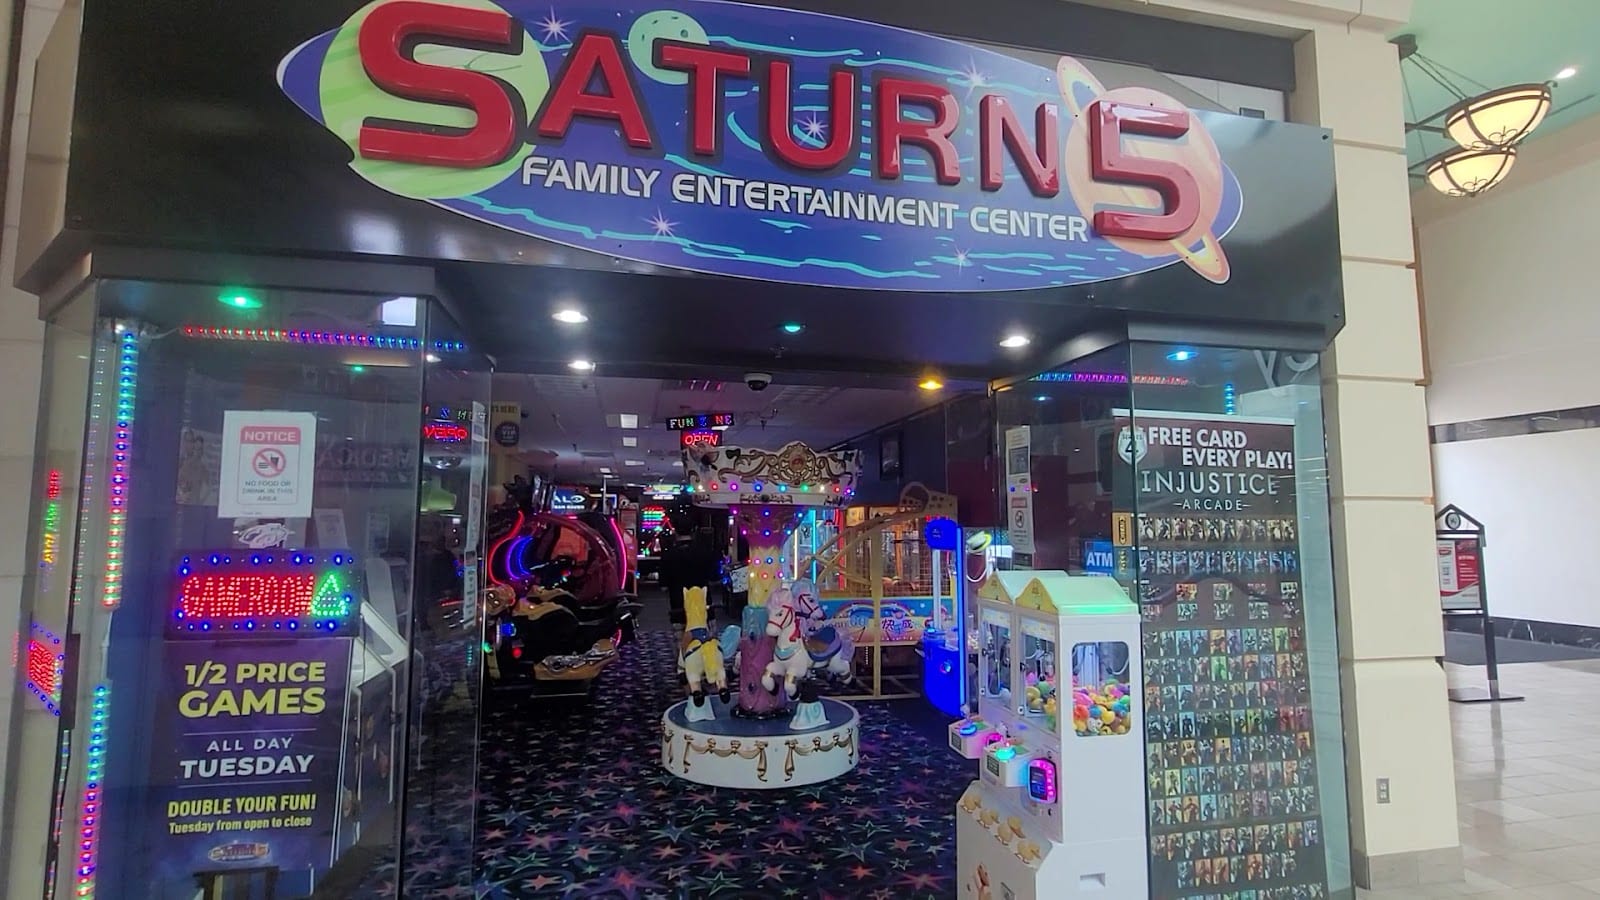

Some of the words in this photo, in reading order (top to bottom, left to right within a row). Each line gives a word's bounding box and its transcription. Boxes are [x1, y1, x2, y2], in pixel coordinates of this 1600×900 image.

[358, 0, 1060, 198] SATURN
[1089, 100, 1202, 240] 5
[522, 156, 661, 198] FAMILY
[672, 174, 960, 230] ENTERTAINMENT
[970, 206, 1089, 243] CENTER
[669, 417, 694, 429] FUN
[699, 414, 732, 427] ZNE
[244, 431, 297, 442] NOTICE
[684, 434, 719, 446] OPEN
[1148, 426, 1192, 447] FREE
[1196, 428, 1248, 449] CARD
[1182, 447, 1241, 468] EVERY
[1245, 450, 1293, 470] PLAY!
[1141, 470, 1281, 495] INJUSTICE
[1182, 499, 1243, 511] ARCADE
[1086, 552, 1113, 568] ATM
[183, 575, 315, 617] GAMEROOM
[184, 660, 227, 687] 1/2
[236, 662, 326, 684] PRICE
[178, 686, 326, 718] GAMES
[207, 739, 244, 752] ALL
[254, 737, 293, 750] DAY
[180, 754, 314, 779] TUESDAY
[167, 798, 233, 818] DOUBLE
[236, 796, 276, 813] YOUR
[280, 794, 317, 811] FUN!
[169, 819, 214, 834] Tuesday
[216, 819, 241, 831] from
[243, 820, 269, 831] open
[271, 818, 282, 828] to
[284, 816, 312, 827] close
